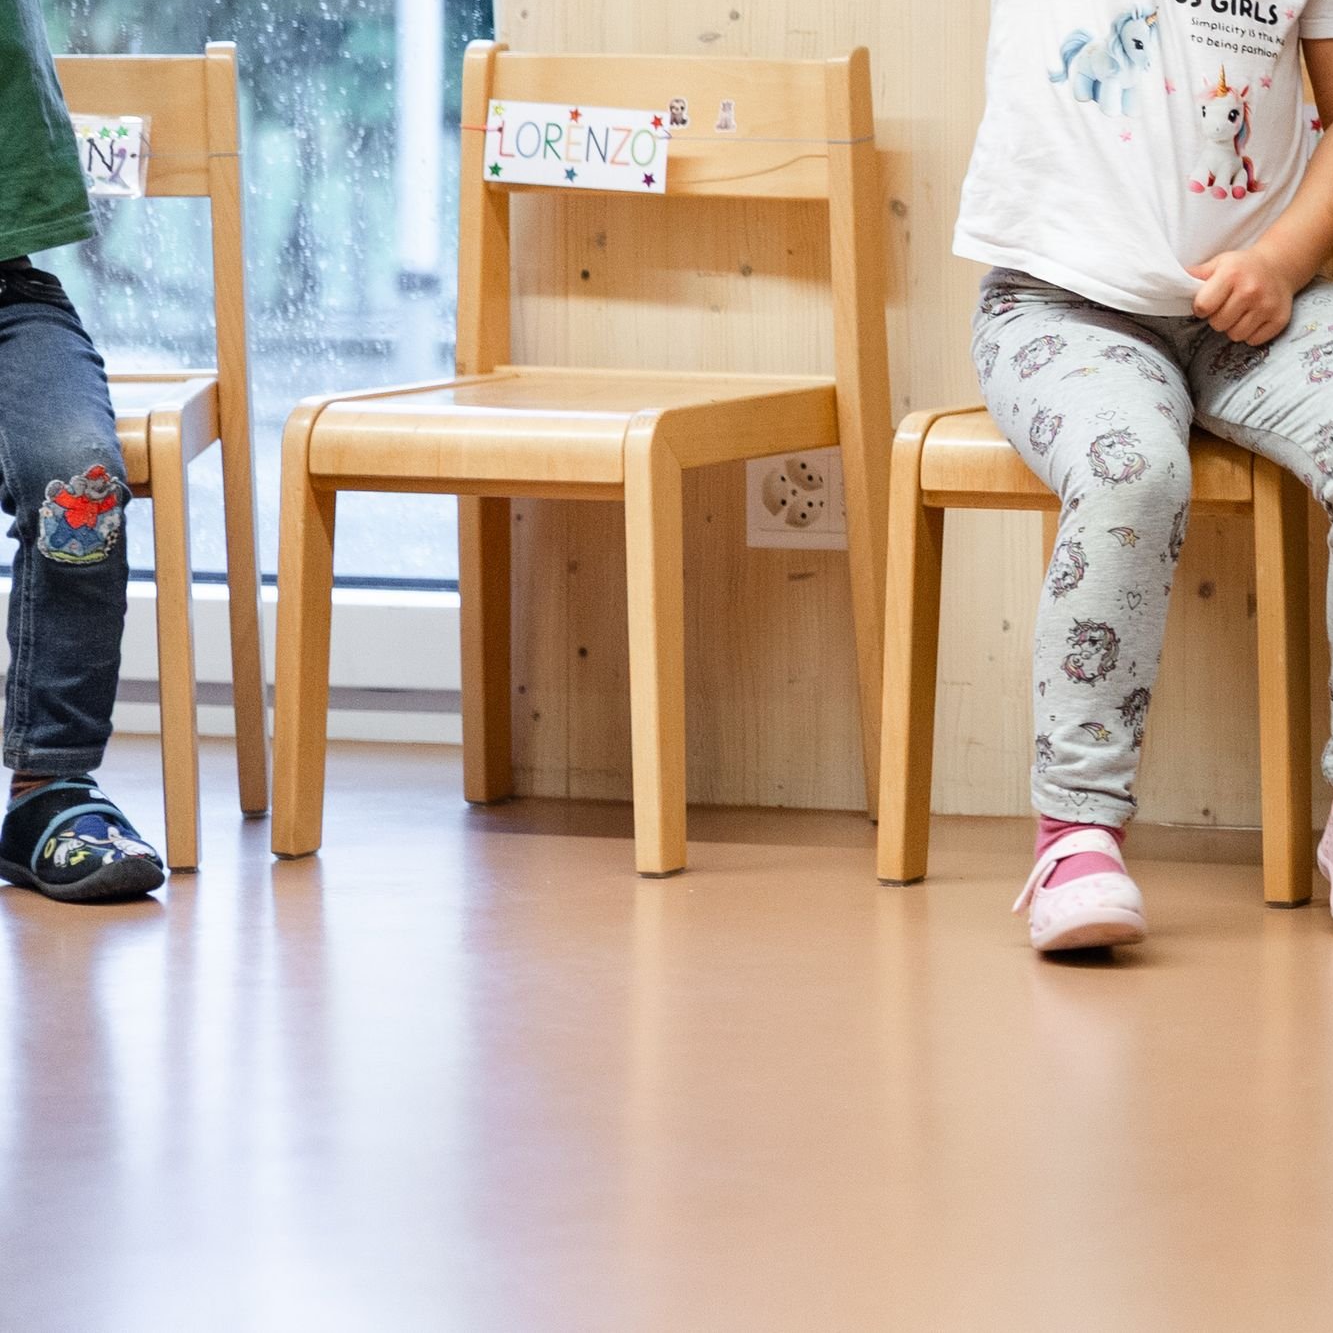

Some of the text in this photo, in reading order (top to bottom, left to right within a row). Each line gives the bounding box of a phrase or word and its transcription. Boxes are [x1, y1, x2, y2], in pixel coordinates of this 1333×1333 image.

[1191, 17, 1246, 38] Simplicity
[1191, 34, 1203, 43] to
[1206, 37, 1239, 54] being
[499, 120, 657, 167] LORENZO
